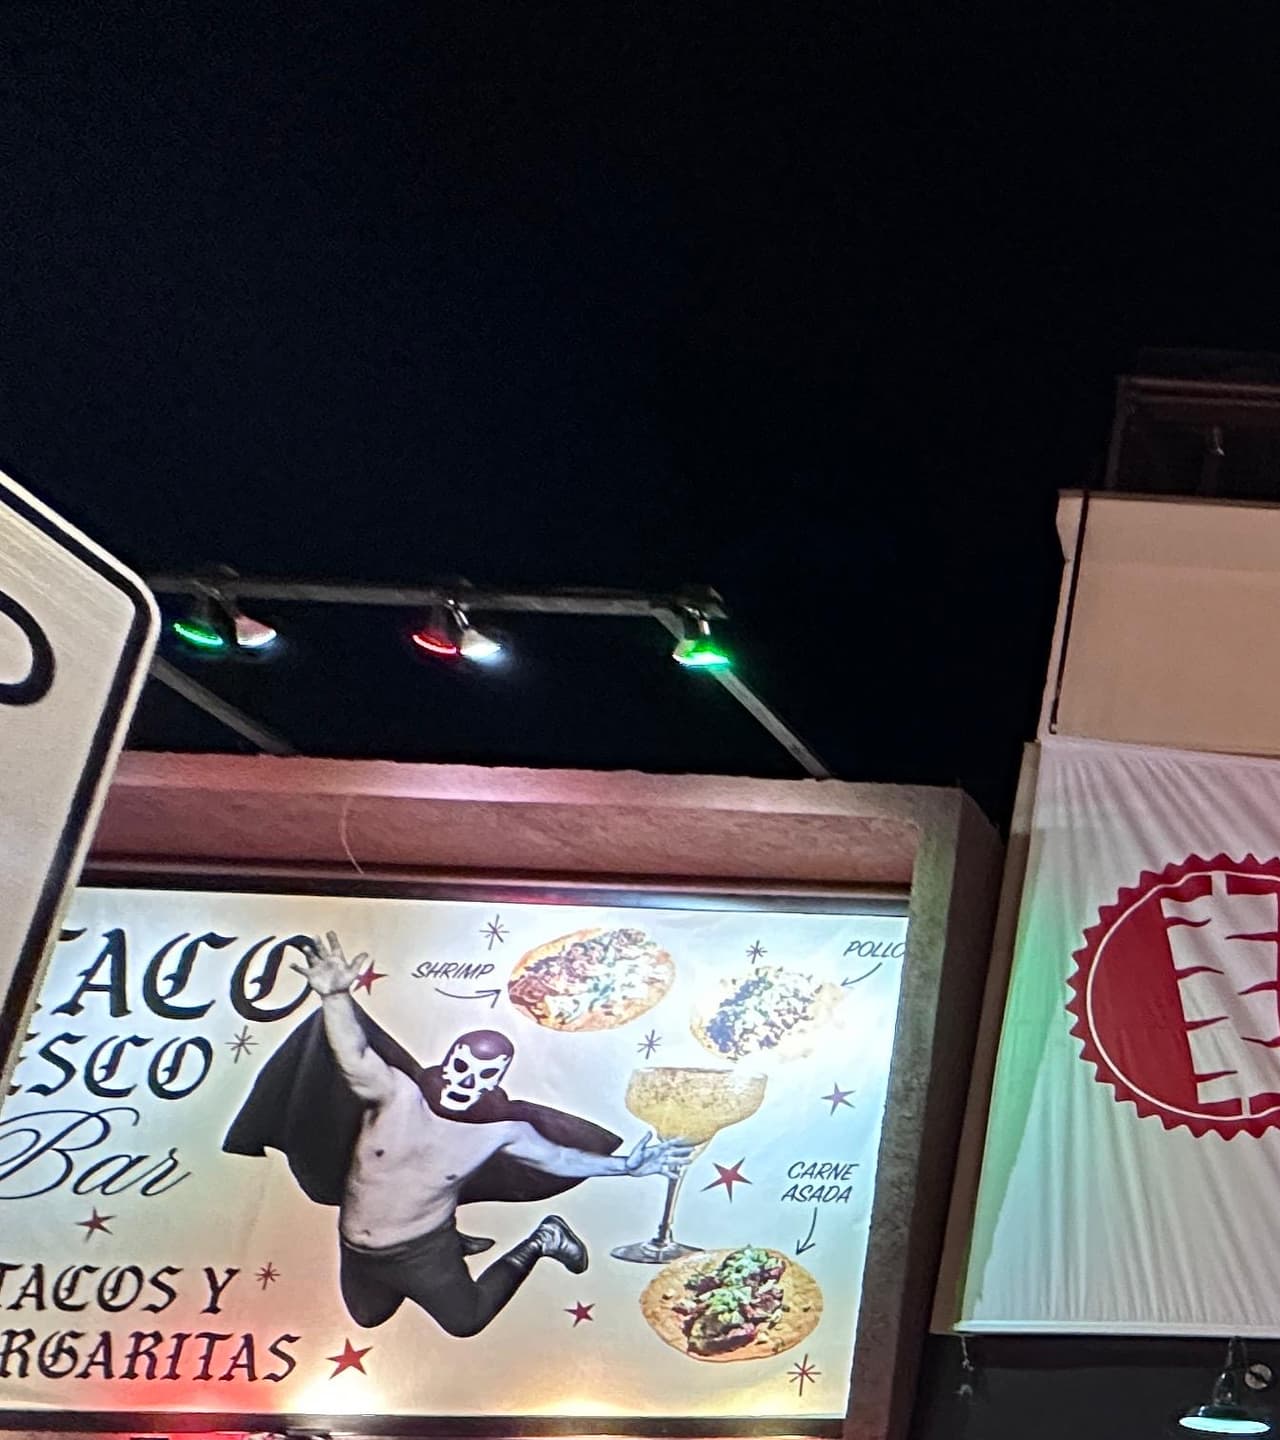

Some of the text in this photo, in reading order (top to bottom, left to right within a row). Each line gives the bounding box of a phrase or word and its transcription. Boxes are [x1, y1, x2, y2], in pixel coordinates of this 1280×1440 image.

[33, 927, 318, 1022] ACO
[411, 961, 495, 979] SHRIMP
[5, 1031, 213, 1100] SCO
[0, 1107, 191, 1199] Bar
[788, 1161, 860, 1180] CARNE
[781, 1184, 852, 1203] ASADA
[200, 1267, 241, 1314] Y
